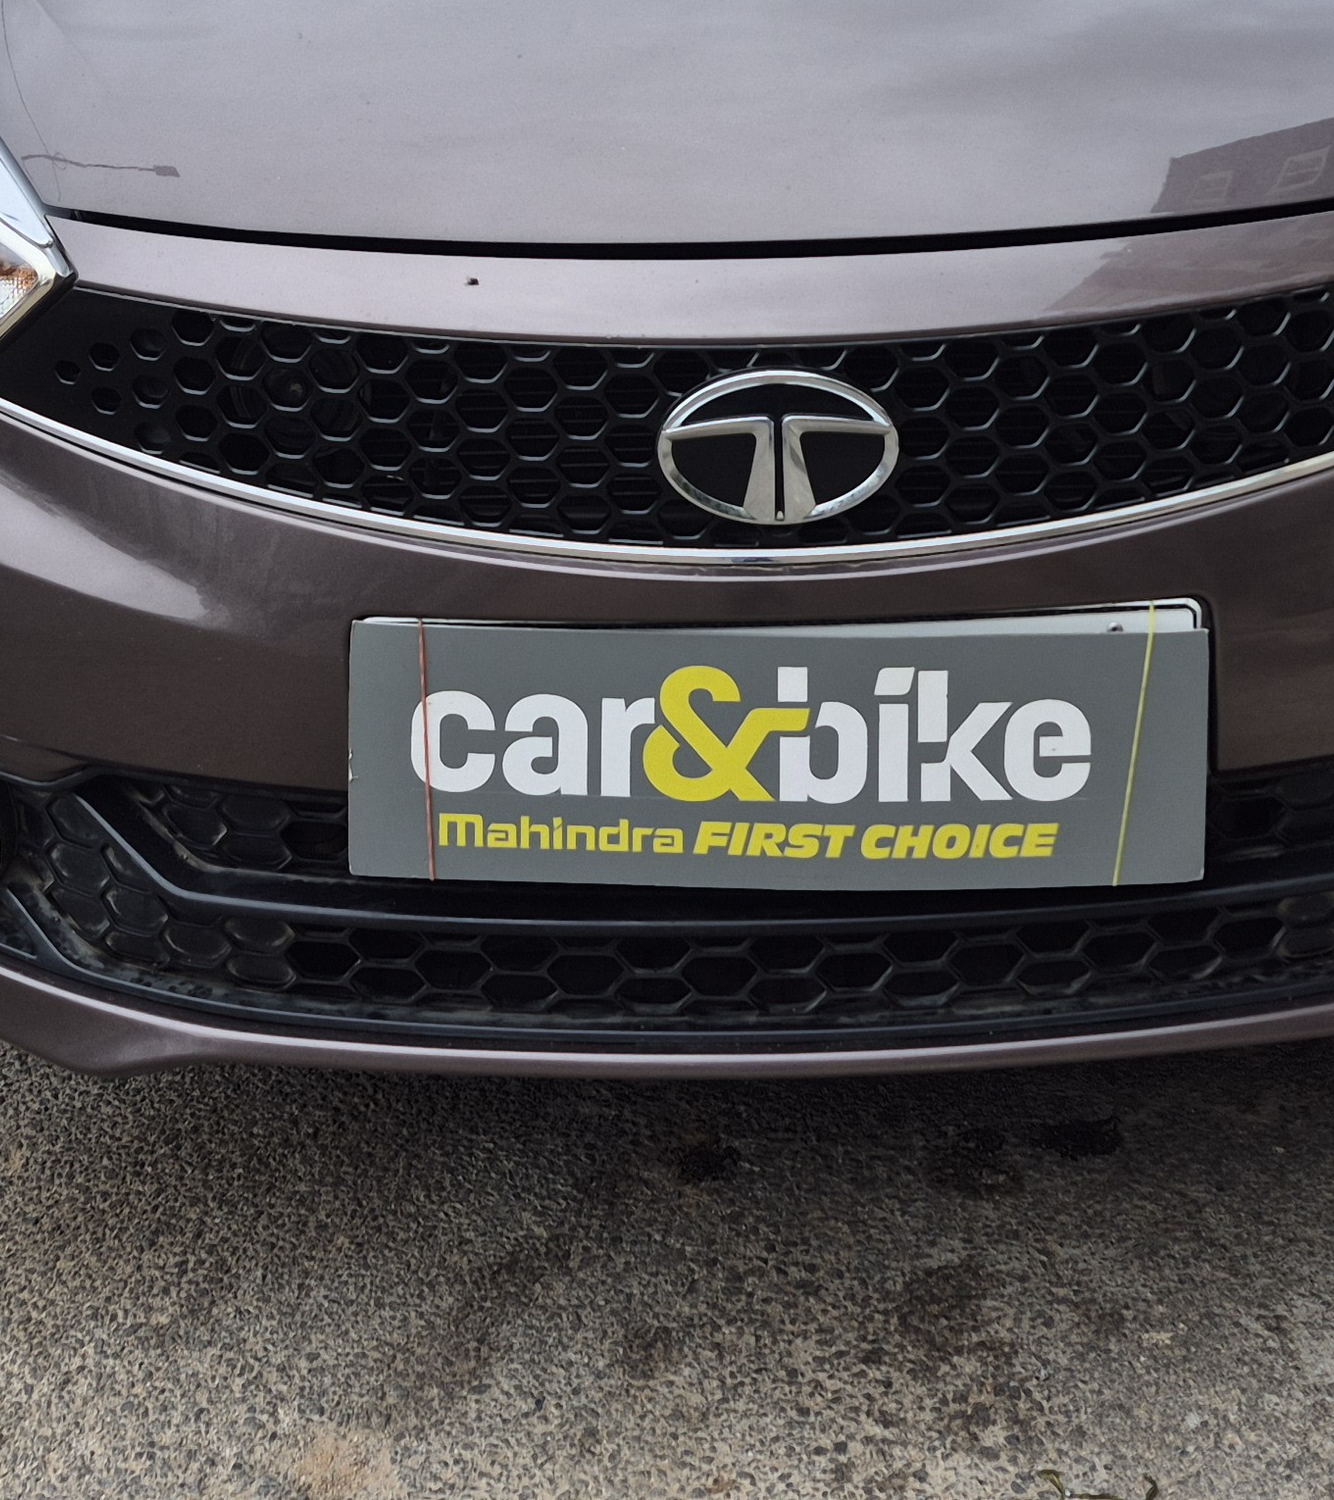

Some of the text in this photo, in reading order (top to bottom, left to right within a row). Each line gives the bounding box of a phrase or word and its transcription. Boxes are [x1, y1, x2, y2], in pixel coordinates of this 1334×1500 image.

[410, 665, 1092, 804] car&bike
[438, 812, 1060, 860] Mahindra FIRST CHOICE
